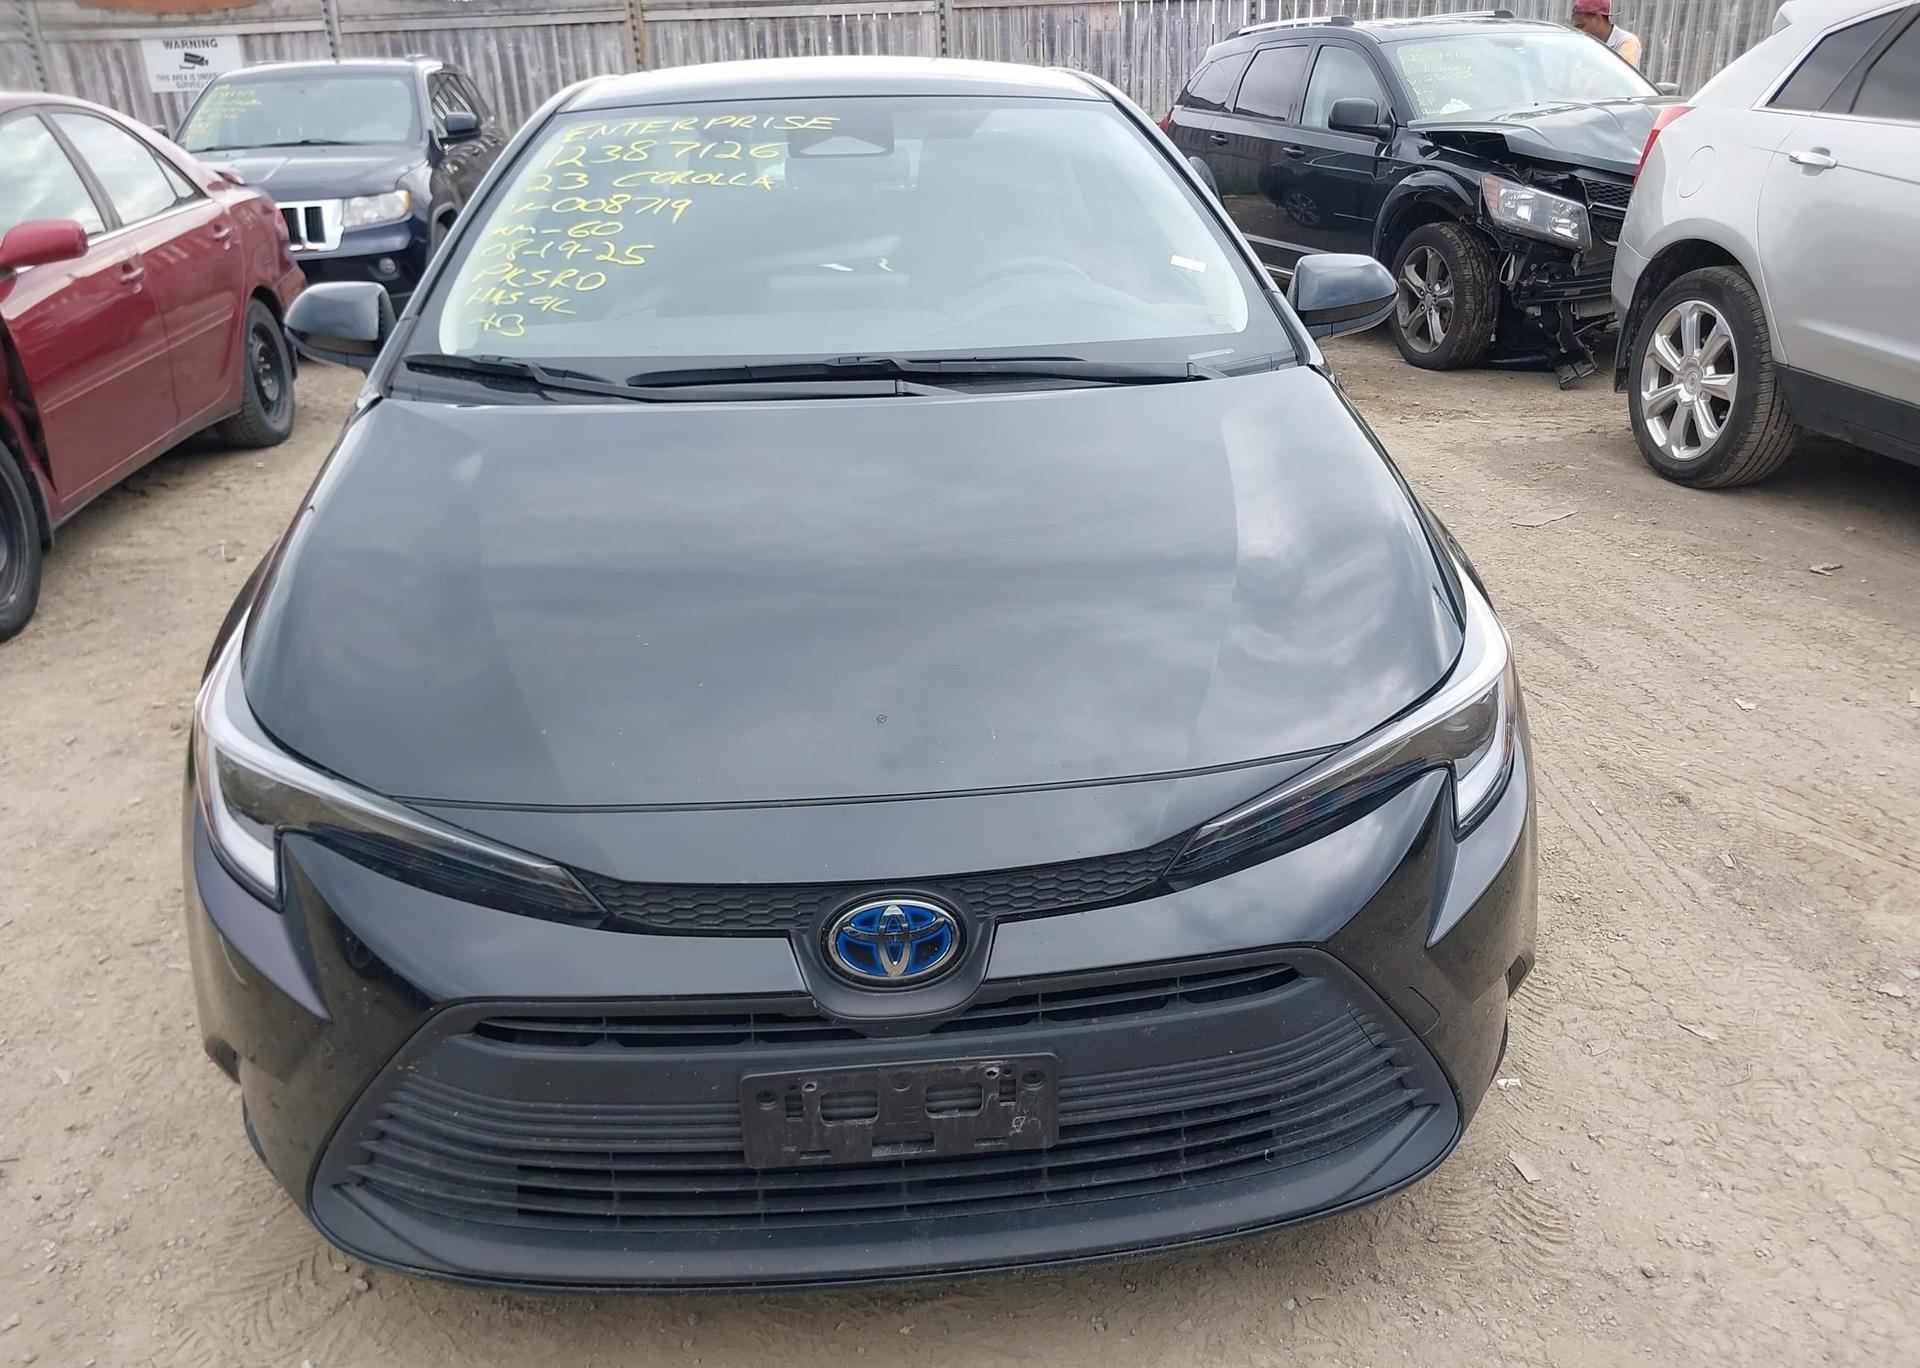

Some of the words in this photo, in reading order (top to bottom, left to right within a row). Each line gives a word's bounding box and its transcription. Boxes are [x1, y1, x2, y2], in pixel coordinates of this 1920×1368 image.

[162, 38, 219, 50] WARNING
[562, 114, 841, 144] ENTERPRISE
[526, 171, 590, 192] 23
[613, 170, 777, 192] COROLLA
